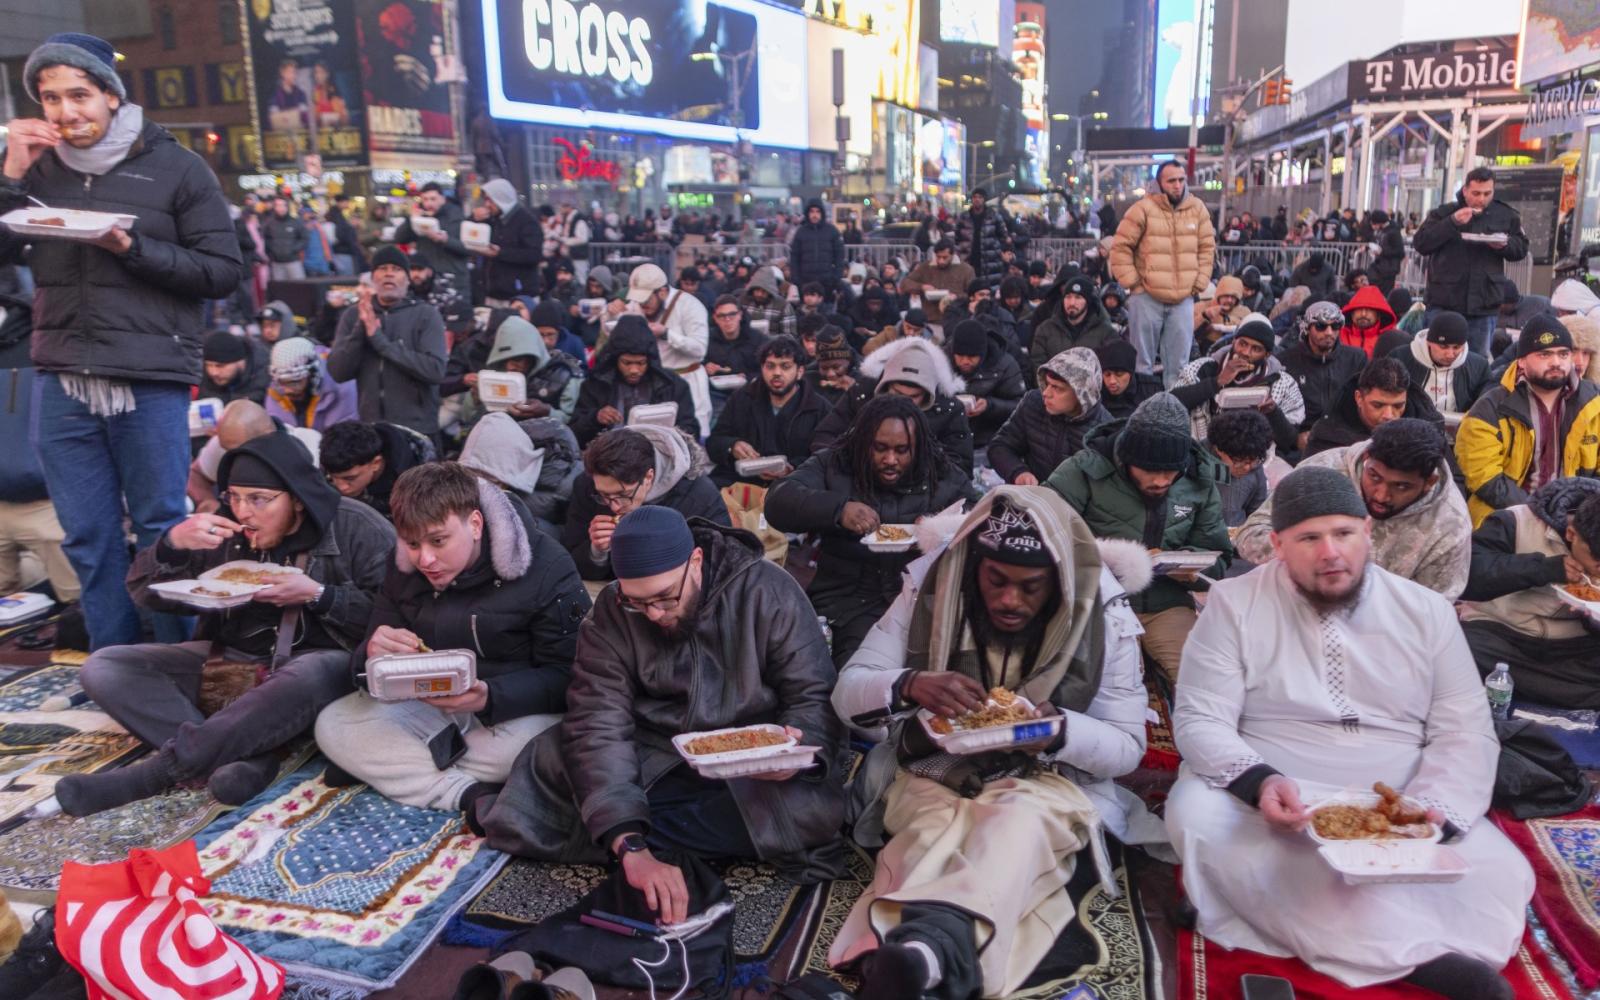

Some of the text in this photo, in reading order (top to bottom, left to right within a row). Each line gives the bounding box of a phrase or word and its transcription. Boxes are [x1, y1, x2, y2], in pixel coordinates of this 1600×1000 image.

[522, 0, 653, 86] CROSS
[1366, 54, 1516, 93] T Mobile
